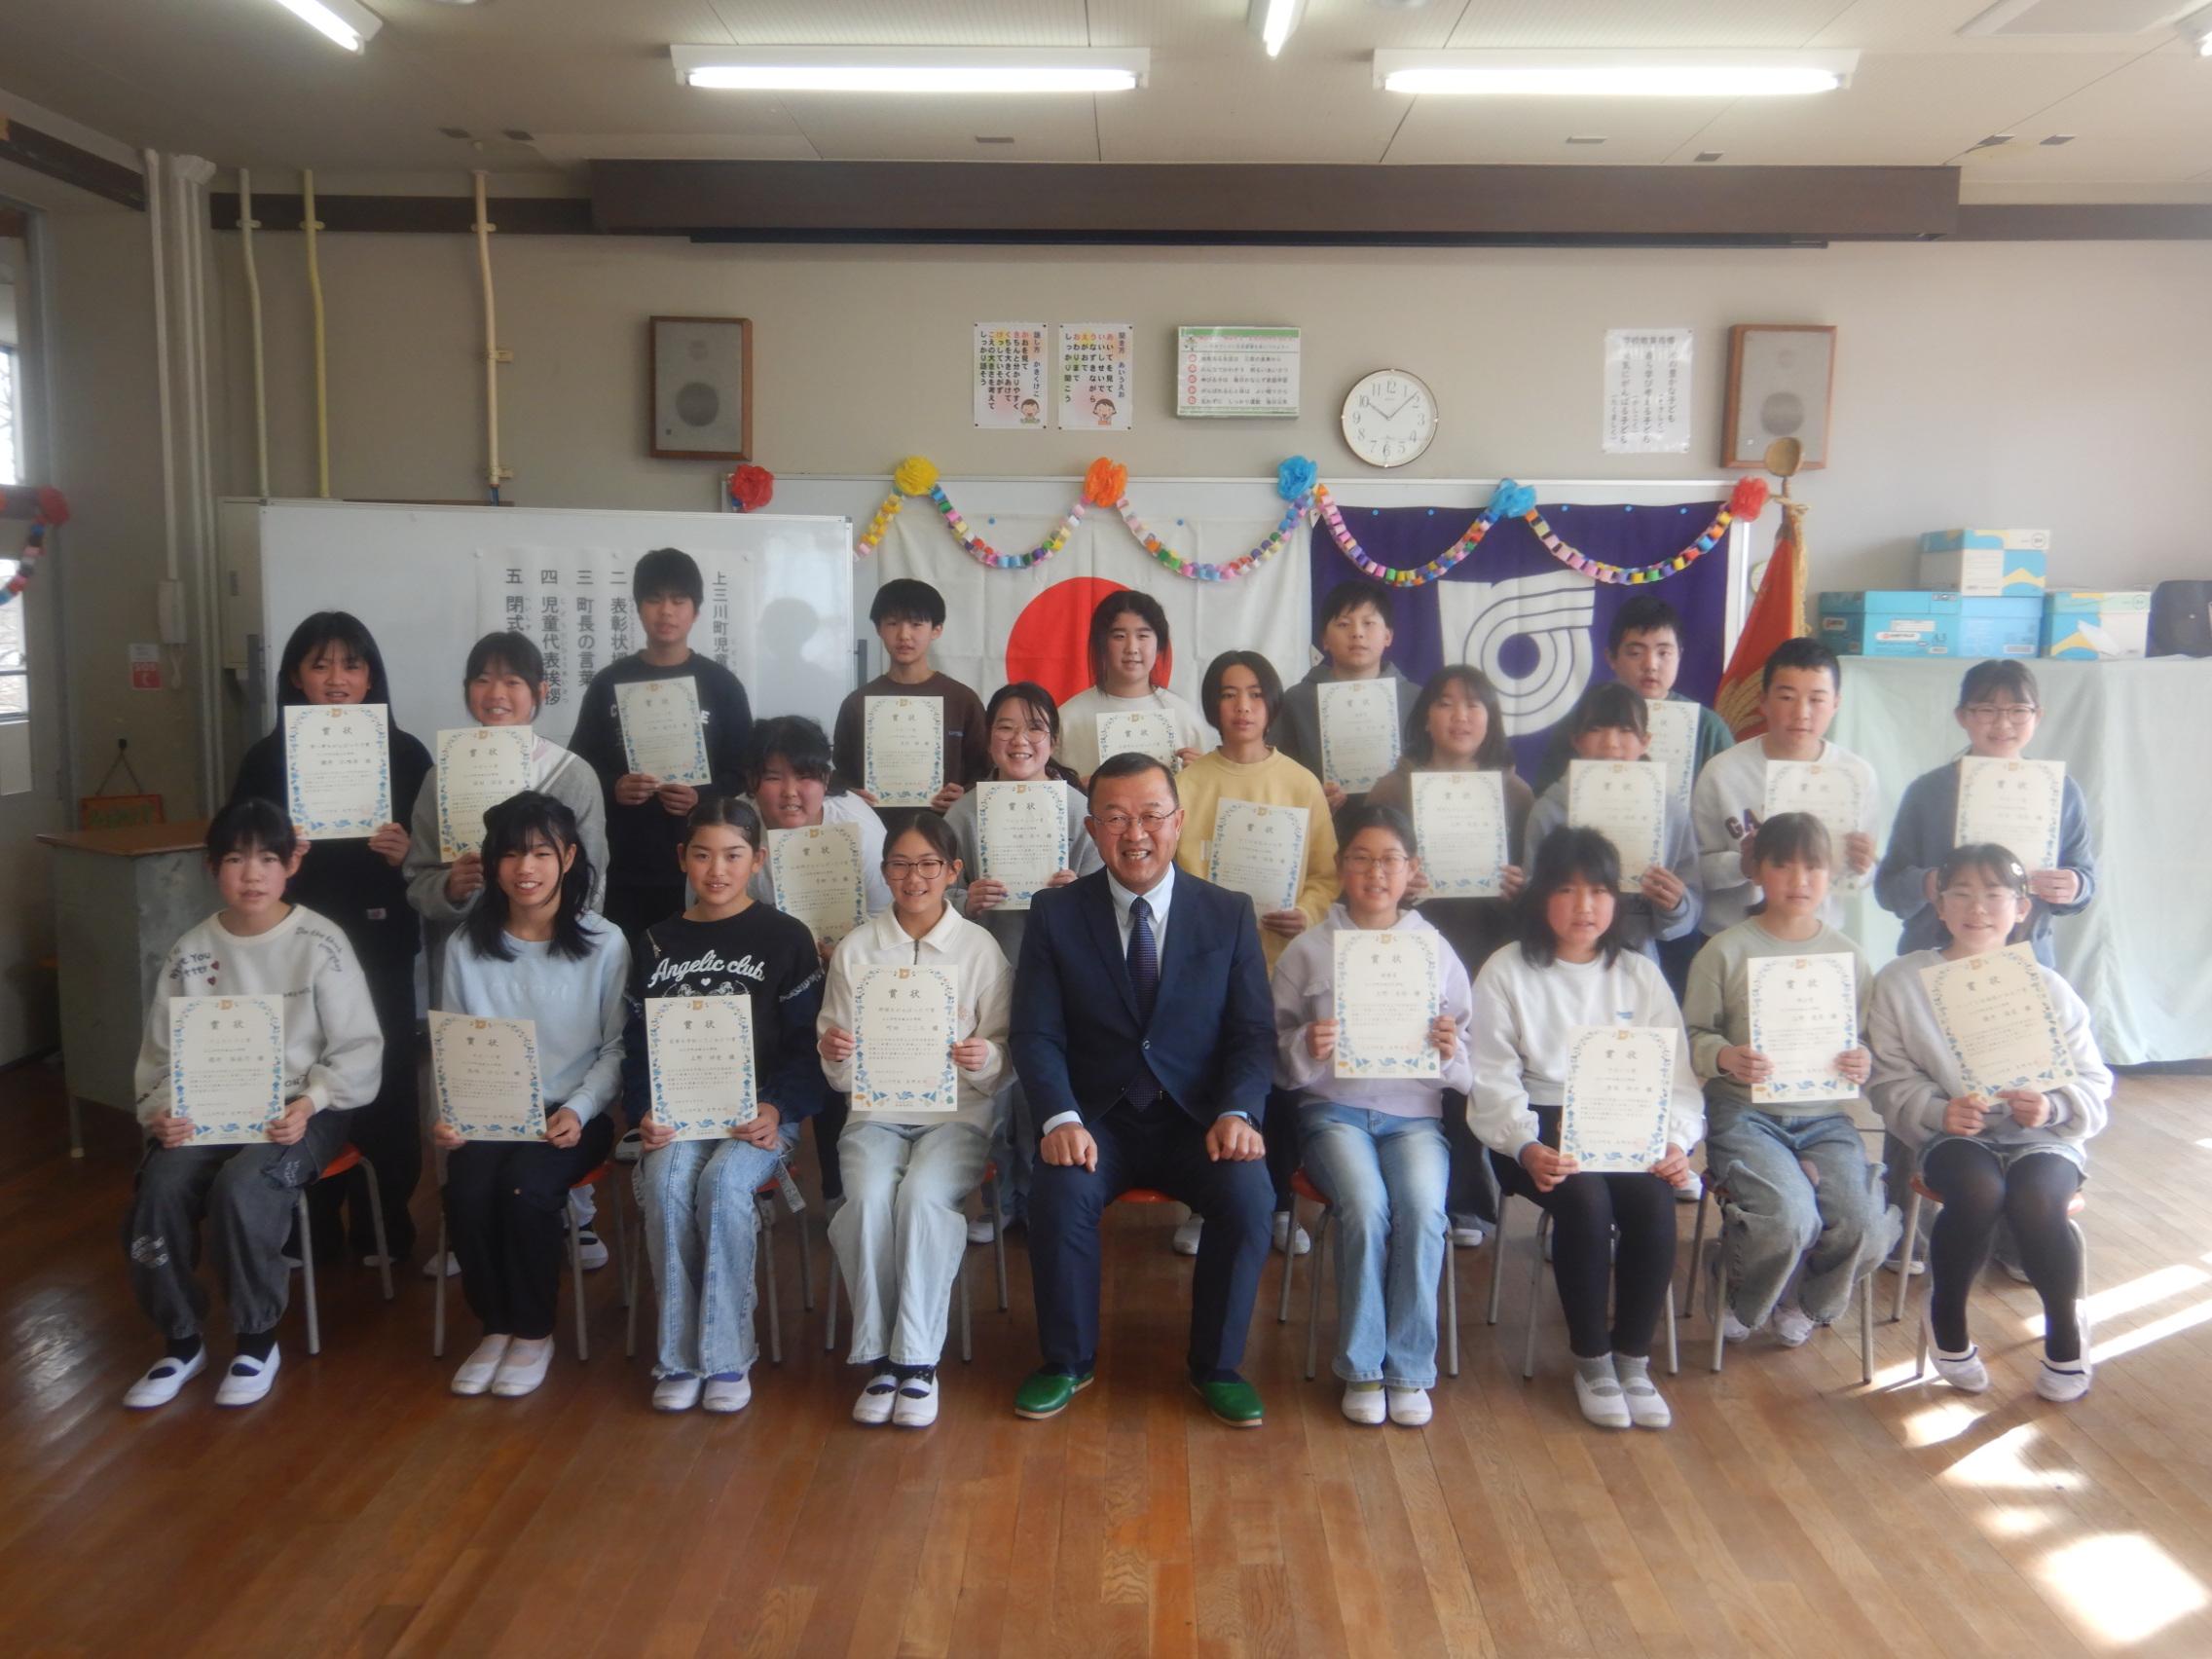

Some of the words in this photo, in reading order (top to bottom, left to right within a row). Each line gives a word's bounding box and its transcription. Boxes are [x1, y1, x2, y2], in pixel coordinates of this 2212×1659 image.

[1372, 384, 1381, 397] 11
[1386, 381, 1396, 393] 12
[1359, 394, 1369, 408] 10
[1352, 412, 1361, 424] 9
[1418, 413, 1425, 426] 3
[1409, 429, 1417, 443] 4
[1370, 440, 1378, 453] 7
[1382, 443, 1390, 457] 6
[504, 569, 524, 584] 五
[540, 570, 558, 584] 四
[576, 570, 594, 584] 三
[609, 571, 627, 584] 二
[576, 597, 595, 686] 町長の言葉
[540, 596, 562, 706] 児童代表挨拶
[647, 949, 725, 988] Angelic
[726, 955, 766, 982] club
